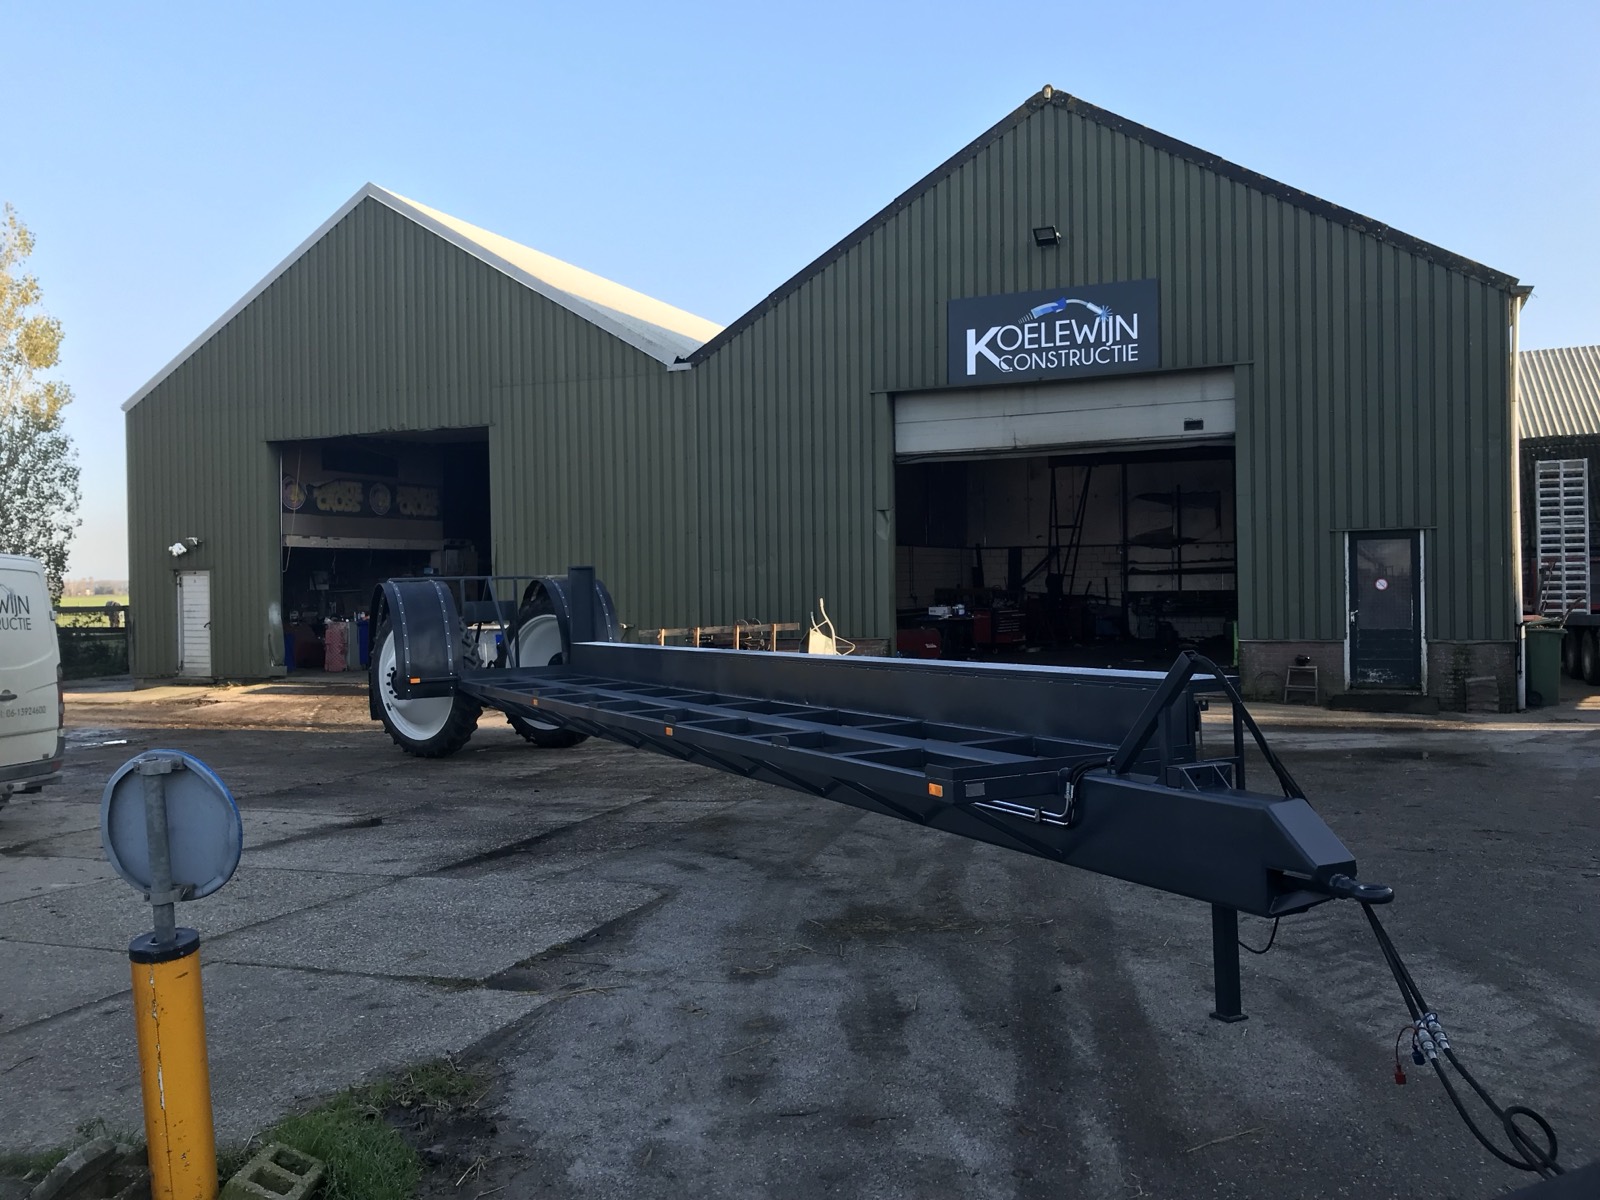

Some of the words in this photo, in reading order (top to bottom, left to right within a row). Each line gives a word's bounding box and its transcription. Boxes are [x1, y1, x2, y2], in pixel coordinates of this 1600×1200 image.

[966, 312, 1139, 376] KOELEWIJN
[1000, 343, 1139, 373] CONSTRUCTIE
[0, 616, 32, 631] UCTIE
